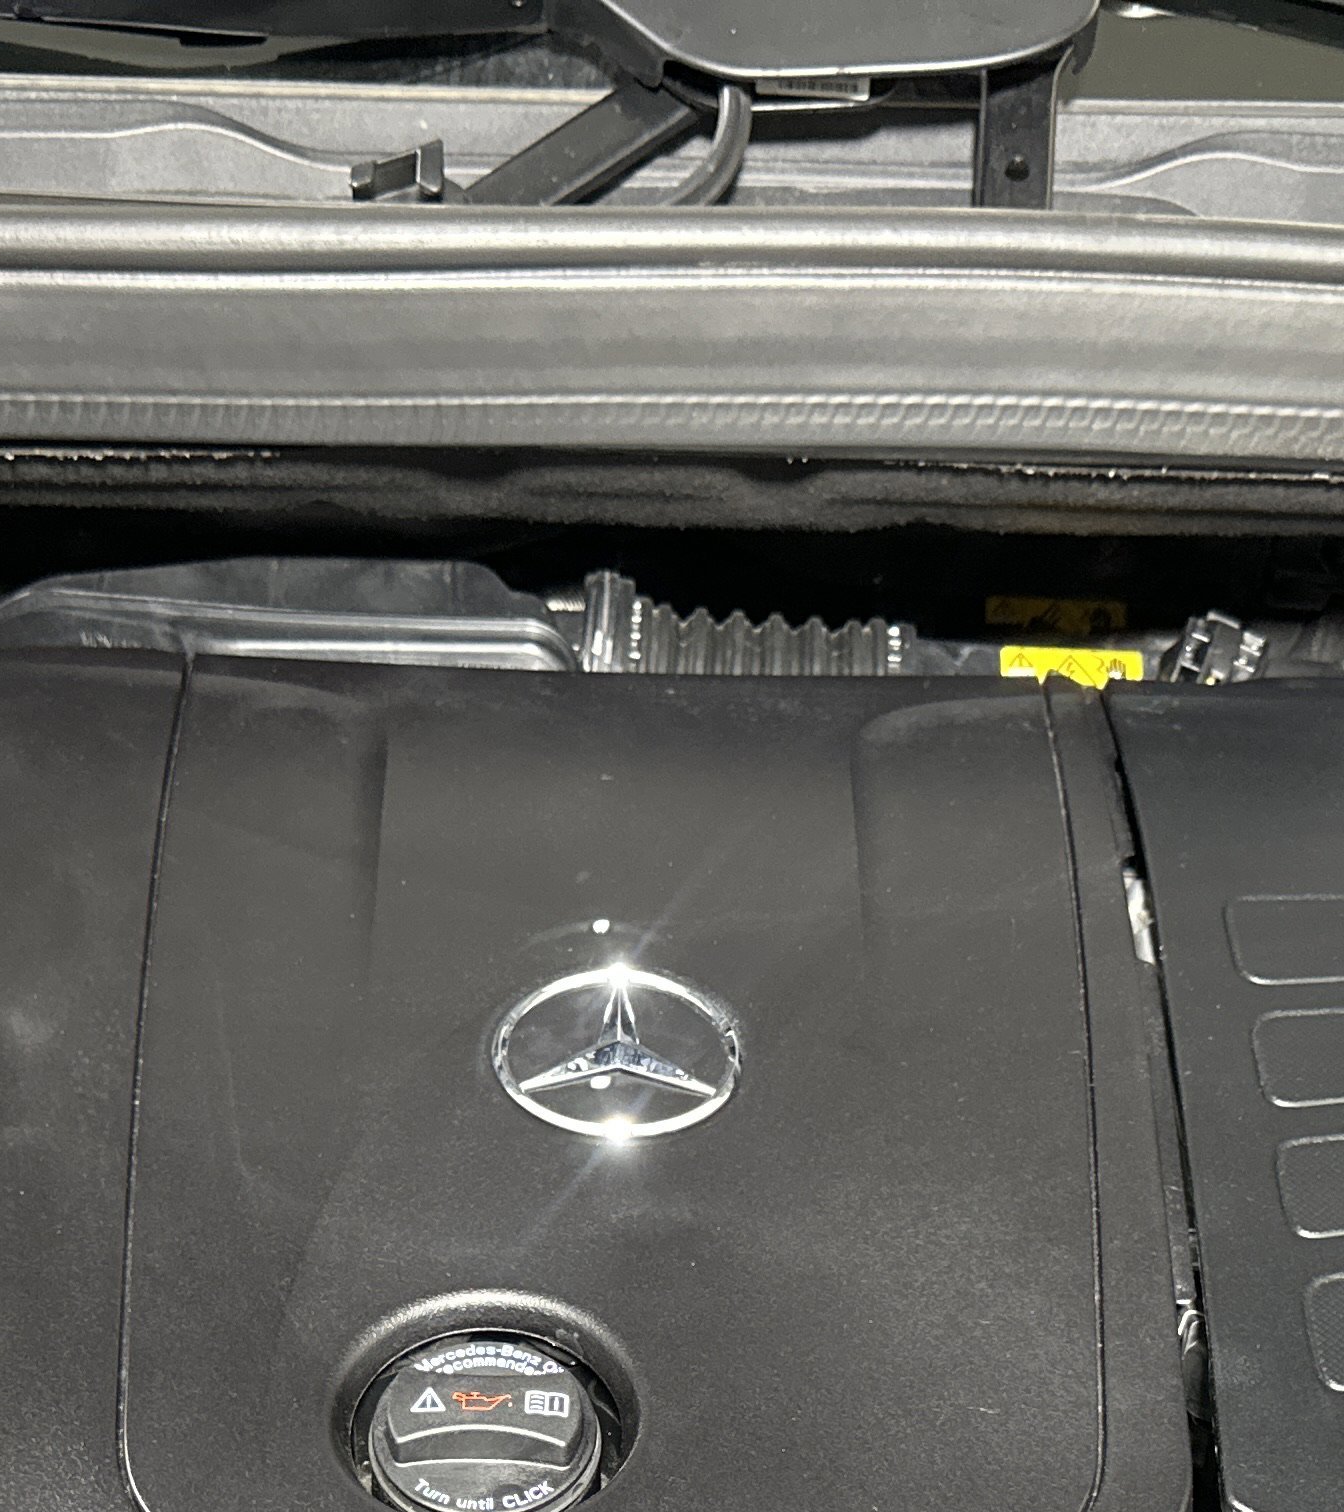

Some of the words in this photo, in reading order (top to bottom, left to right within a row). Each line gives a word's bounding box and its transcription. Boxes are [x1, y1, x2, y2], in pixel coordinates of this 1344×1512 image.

[414, 1478, 450, 1505] Turn
[456, 1497, 494, 1510] until
[502, 1481, 554, 1508] CLICK
